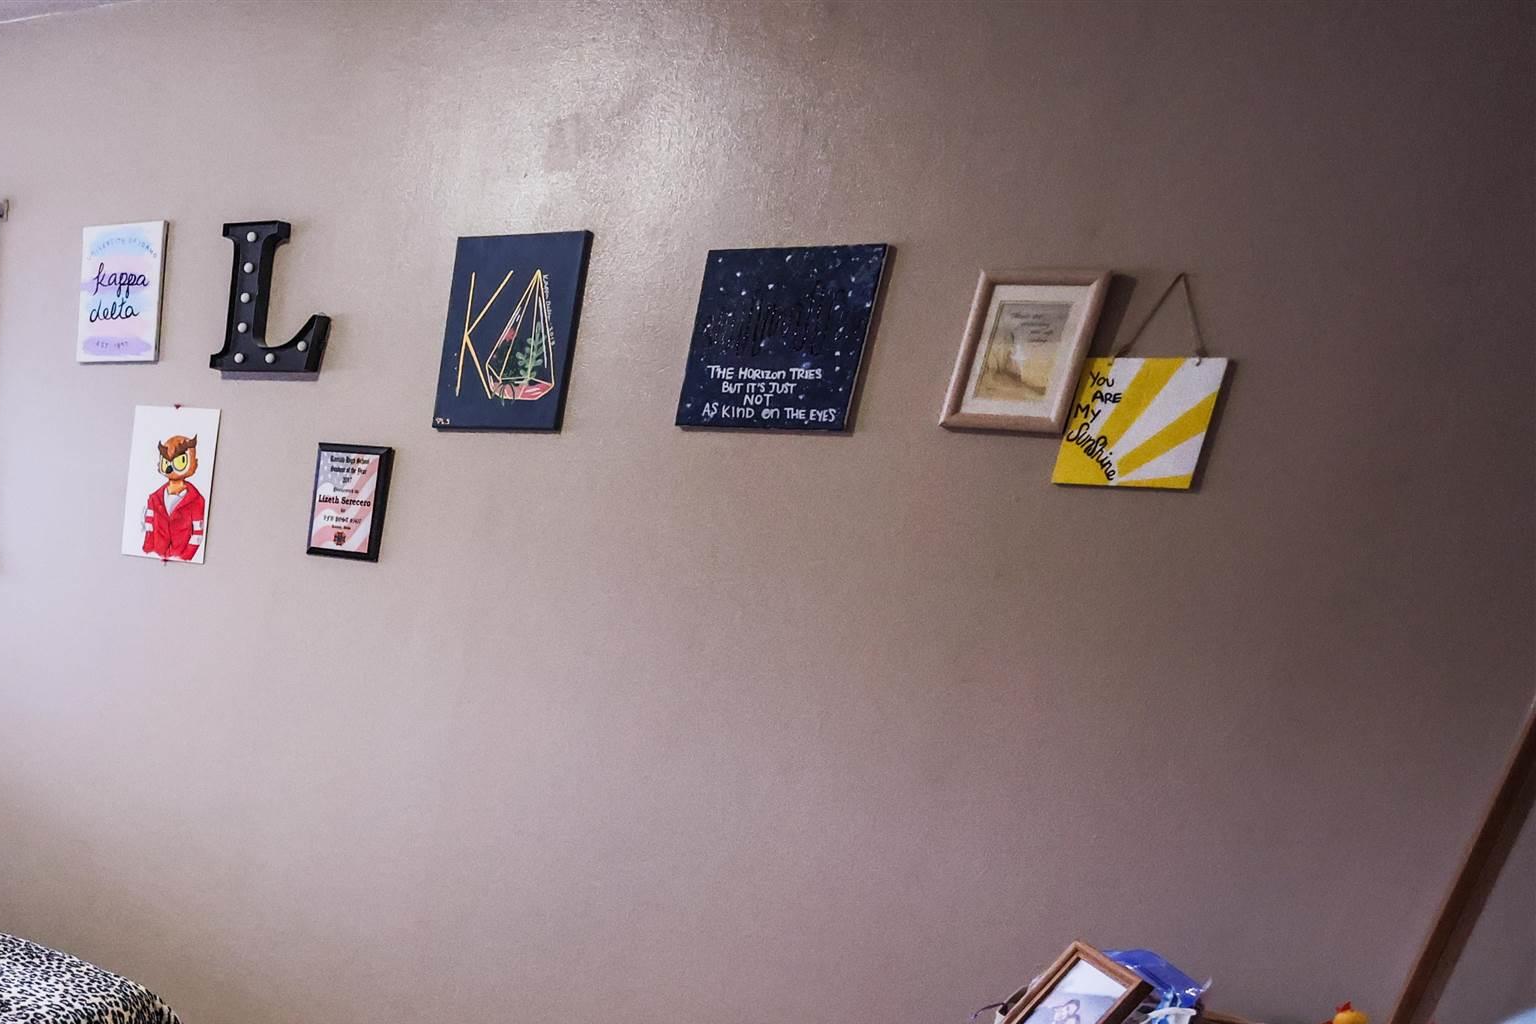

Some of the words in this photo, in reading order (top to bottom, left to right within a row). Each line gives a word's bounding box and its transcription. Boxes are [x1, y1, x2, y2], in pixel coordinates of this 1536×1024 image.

[93, 262, 150, 298] kappa
[209, 220, 331, 372] L
[89, 297, 141, 323] delta
[707, 365, 735, 380] THE
[789, 367, 822, 380] TRIES
[722, 381, 744, 394] BUT
[746, 382, 766, 394] IT'S
[769, 382, 797, 394] JUST
[743, 394, 774, 407] NOT
[1091, 390, 1122, 404] ARE
[702, 402, 719, 417] AS
[784, 407, 806, 420] THE
[809, 408, 837, 422] EYES
[318, 494, 340, 505] Lizeth
